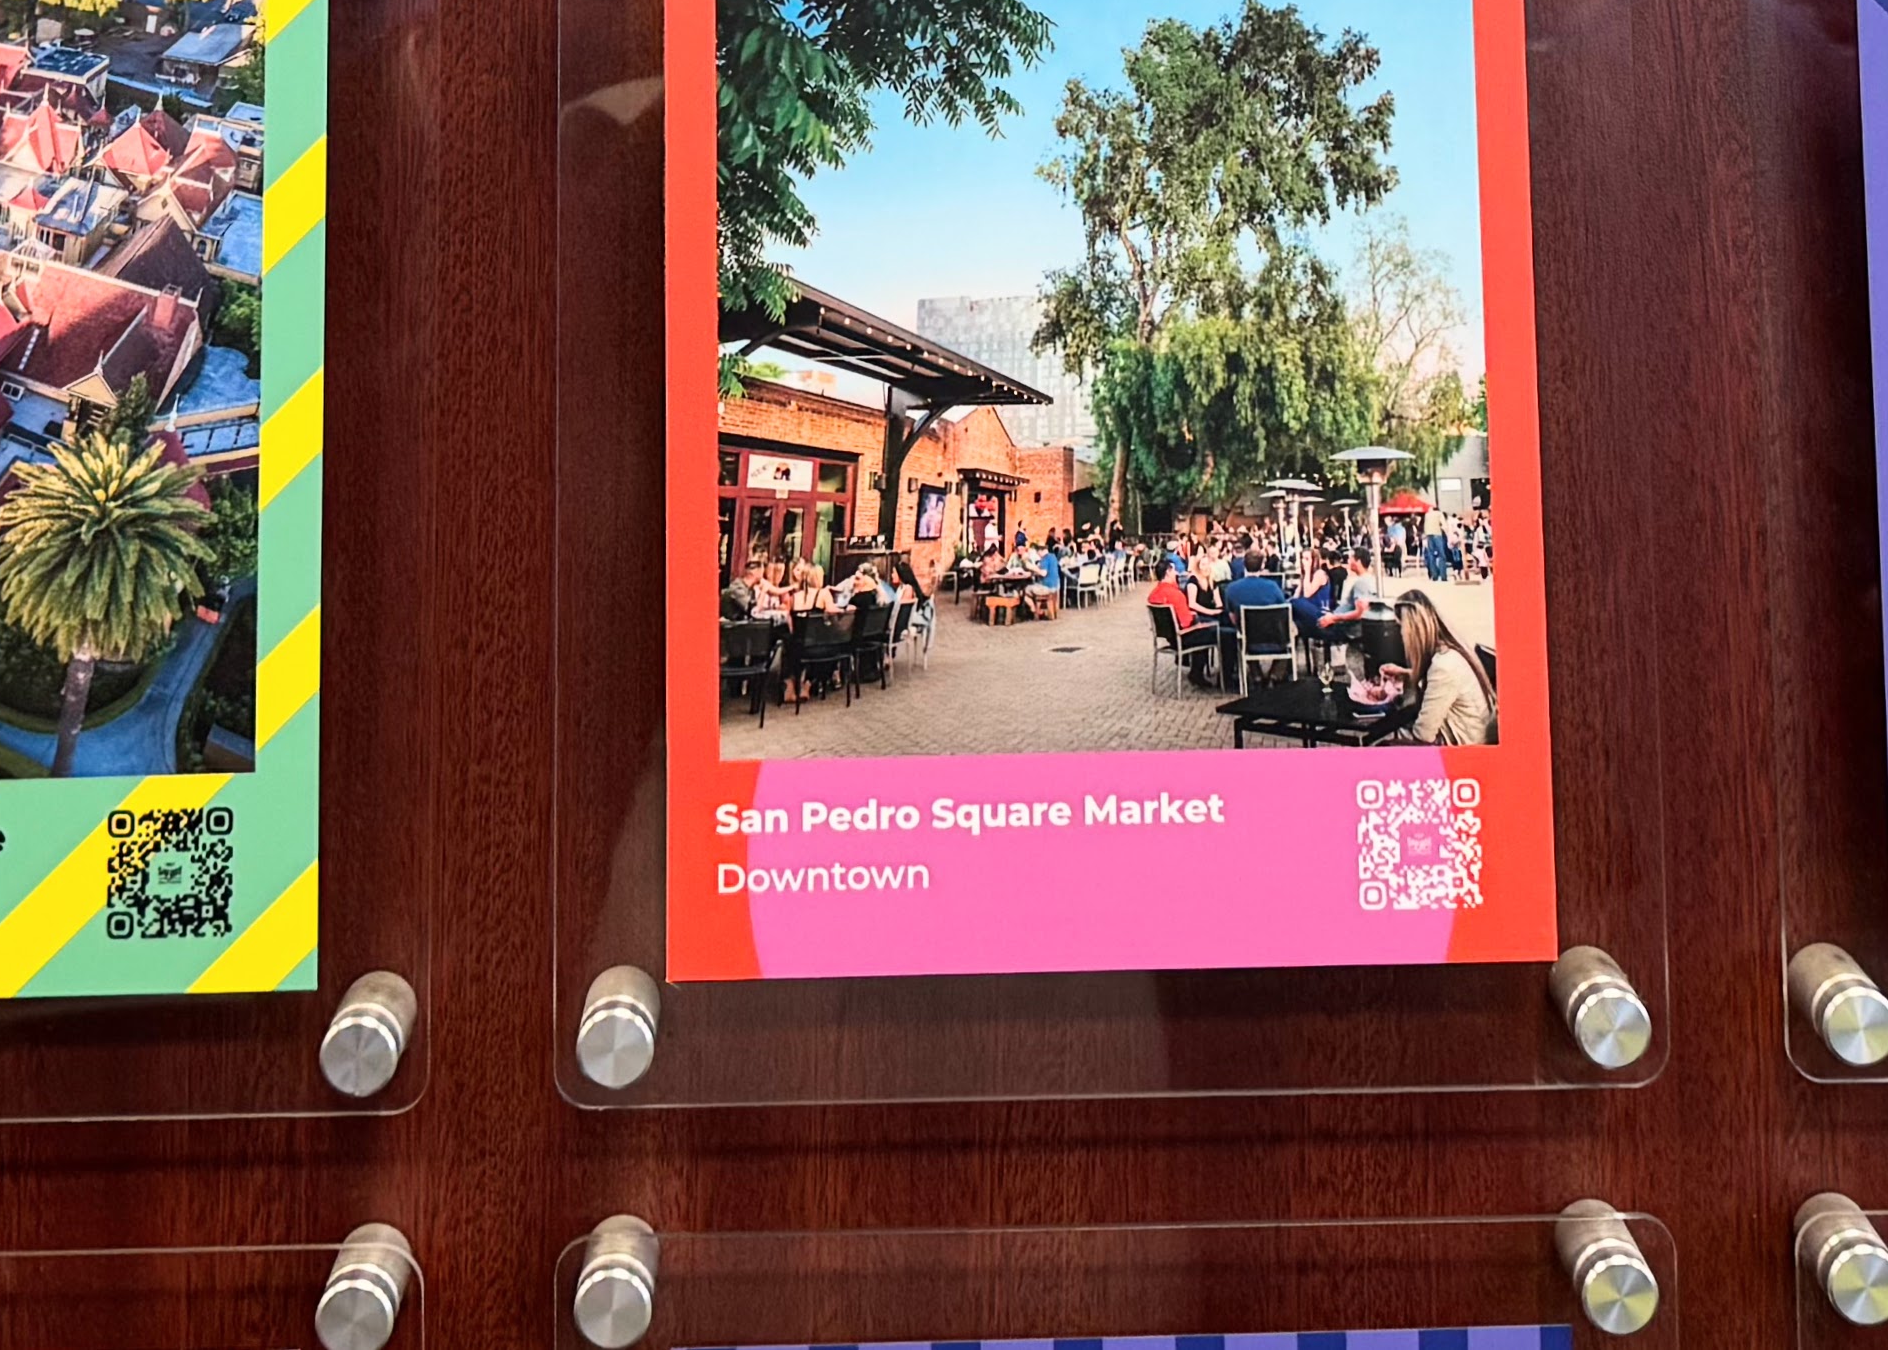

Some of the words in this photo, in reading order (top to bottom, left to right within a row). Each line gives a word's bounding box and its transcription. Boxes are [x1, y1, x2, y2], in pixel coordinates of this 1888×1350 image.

[715, 803, 789, 836] San
[802, 800, 920, 833] Pedro
[931, 798, 1073, 836] Square
[1083, 794, 1225, 826] Market
[717, 862, 930, 895] Downtown
